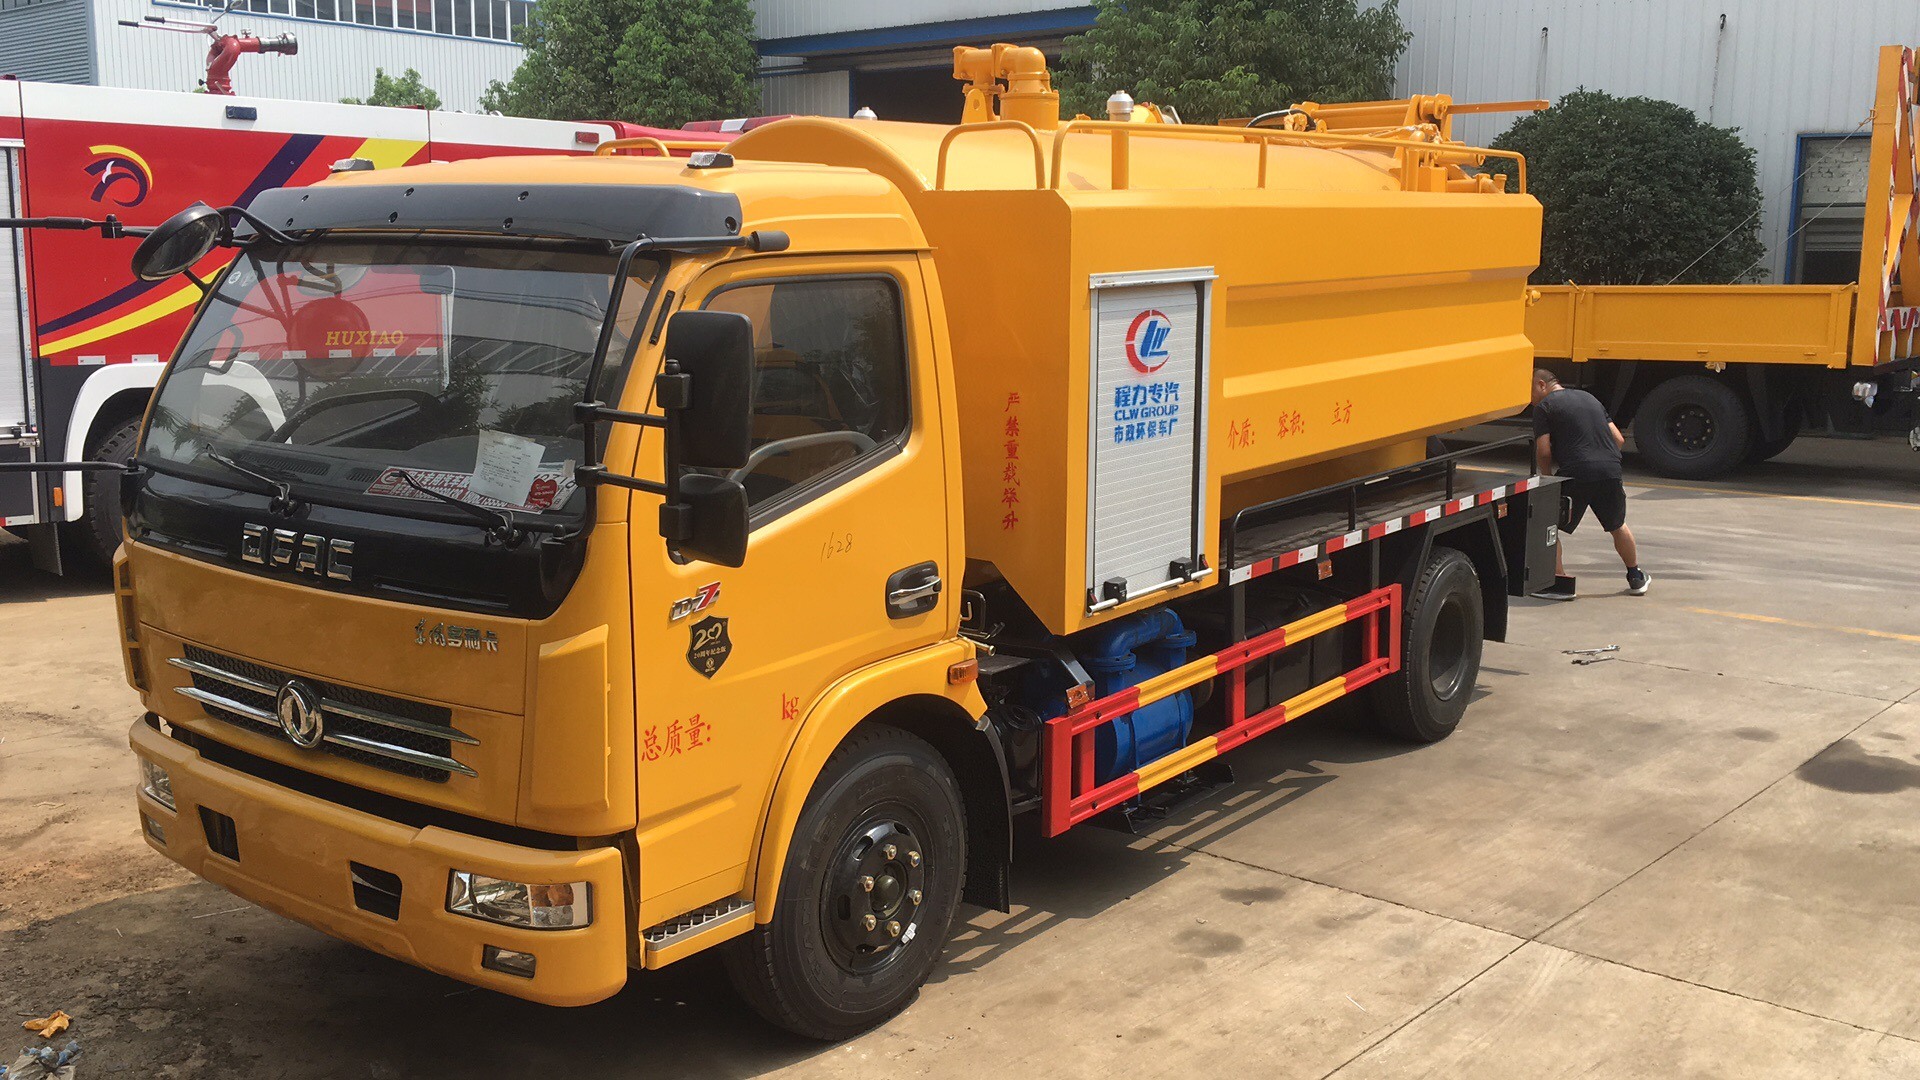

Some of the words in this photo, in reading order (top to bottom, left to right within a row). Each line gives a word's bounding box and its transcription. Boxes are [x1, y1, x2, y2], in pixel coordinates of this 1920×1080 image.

[325, 330, 404, 346] HUXIAO
[1114, 382, 1180, 408] 程力专汽
[1114, 408, 1139, 421] CLW
[1141, 404, 1179, 418] GROUP
[1332, 400, 1352, 425] 立方
[1114, 418, 1178, 443] 市政环保车厂
[1001, 392, 1021, 531] 严禁重载举升
[242, 522, 355, 581] DFAC
[821, 532, 853, 563] 1628
[670, 581, 721, 620] D7
[641, 713, 711, 761] 总质量:
[782, 693, 799, 720] kg
